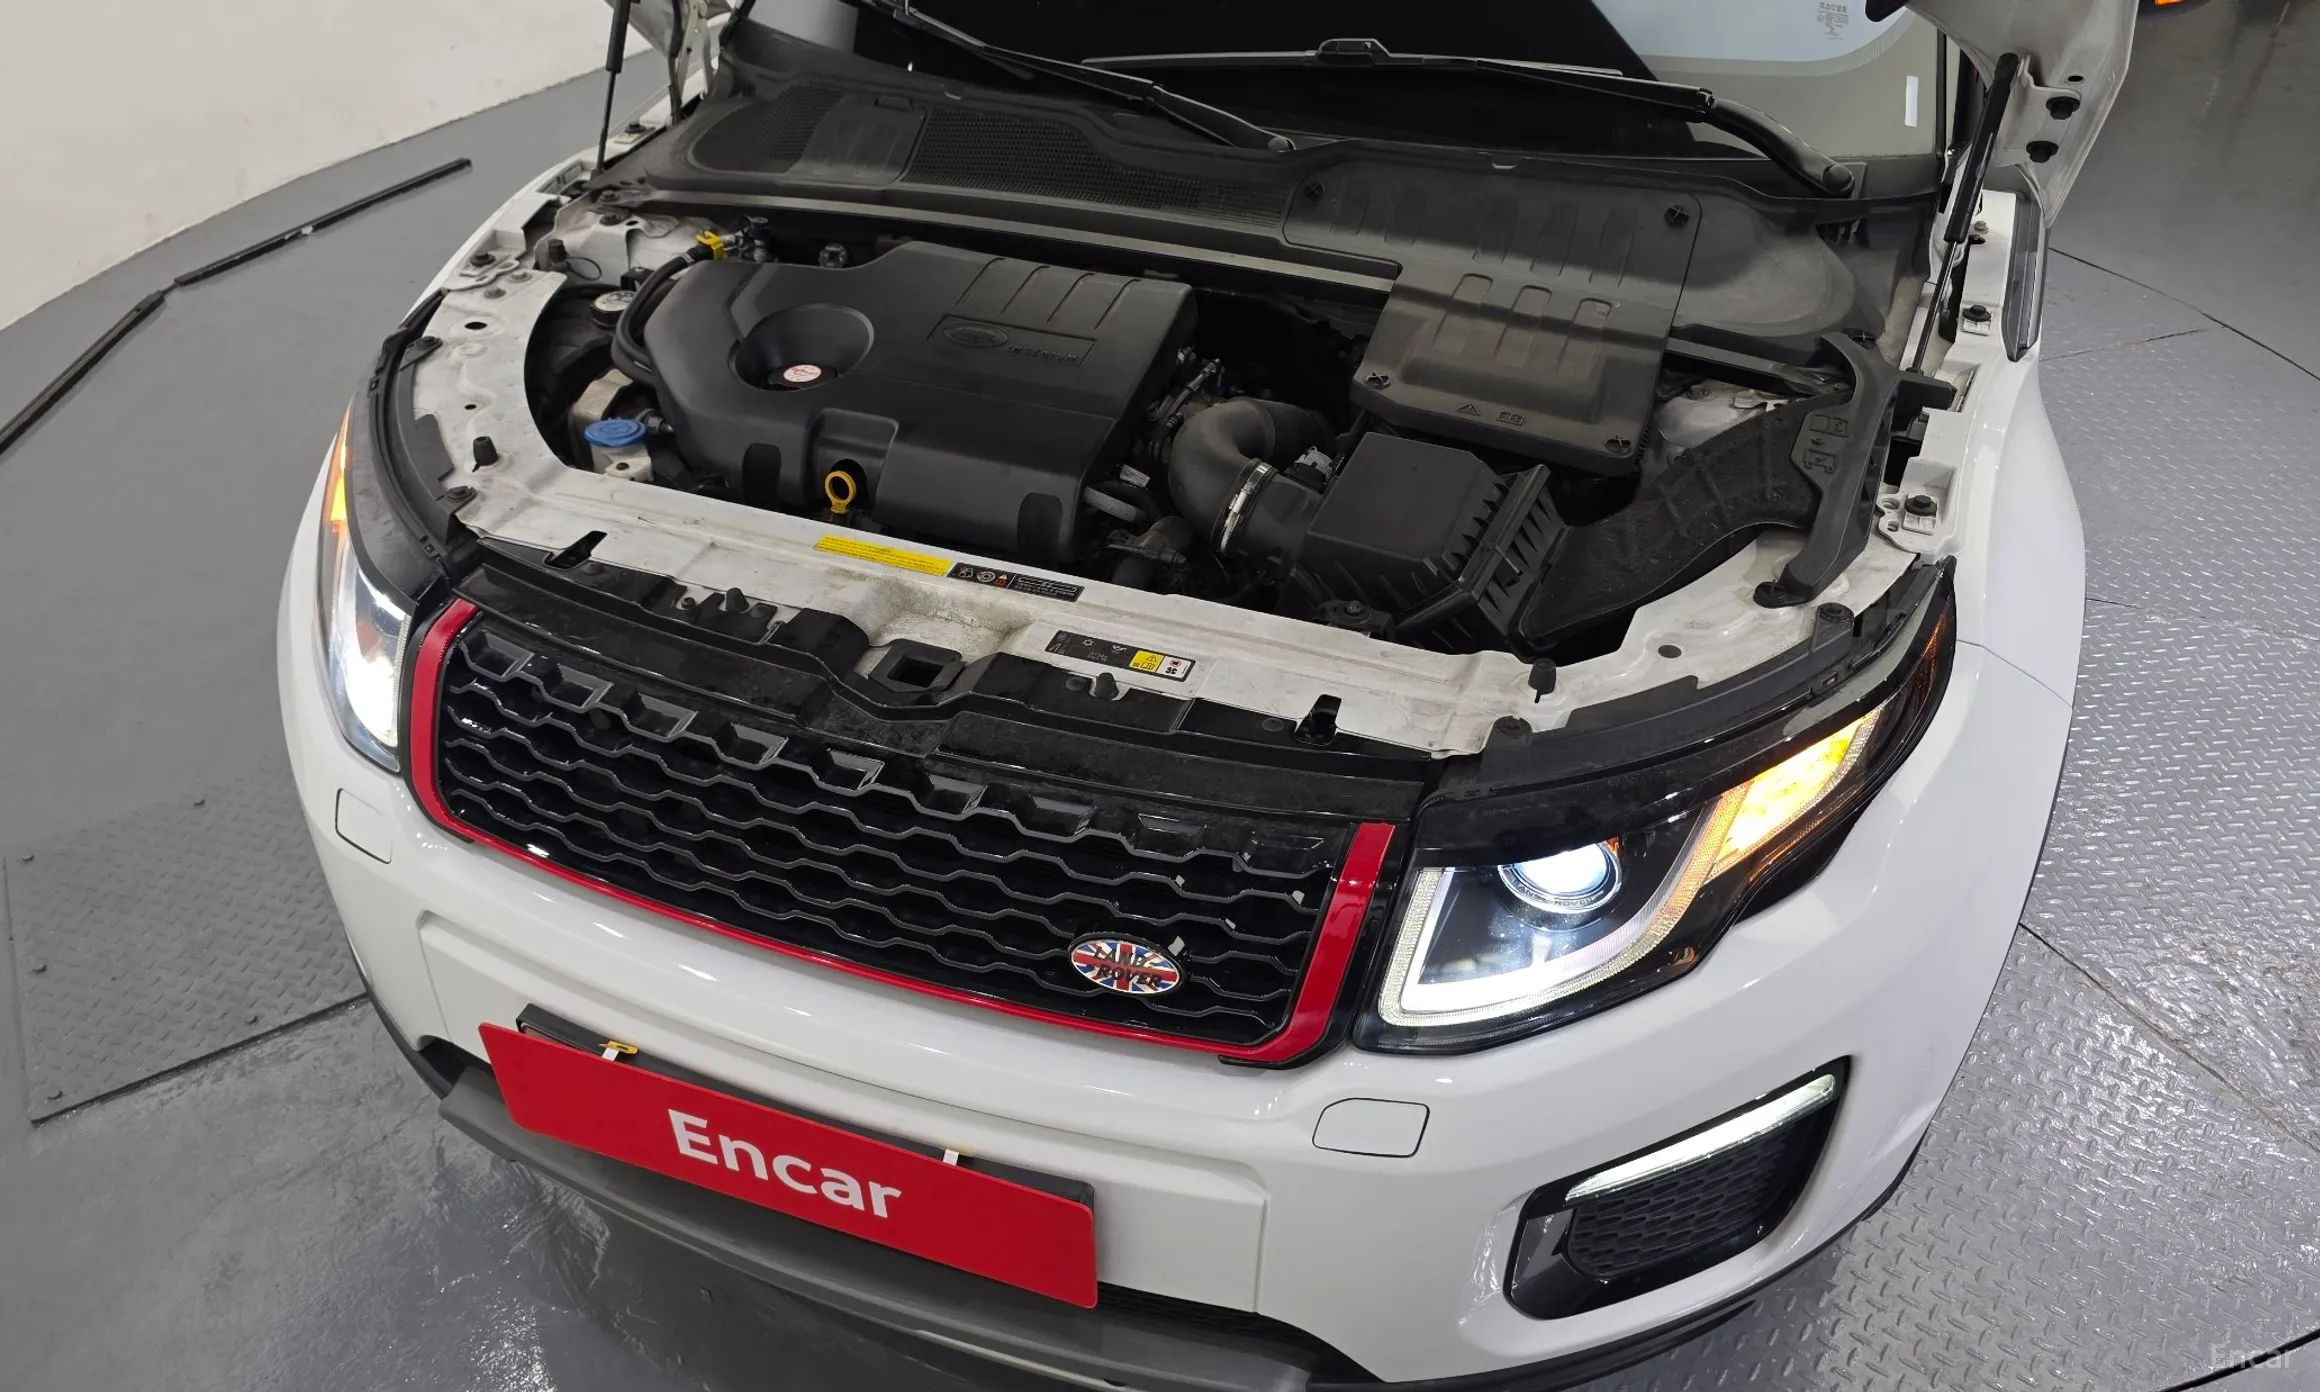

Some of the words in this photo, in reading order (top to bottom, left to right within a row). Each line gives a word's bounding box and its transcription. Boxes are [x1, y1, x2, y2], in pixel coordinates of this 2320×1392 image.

[1094, 946, 1147, 966] LAND
[1098, 964, 1161, 986] ROVER
[667, 1108, 903, 1219] Encar
